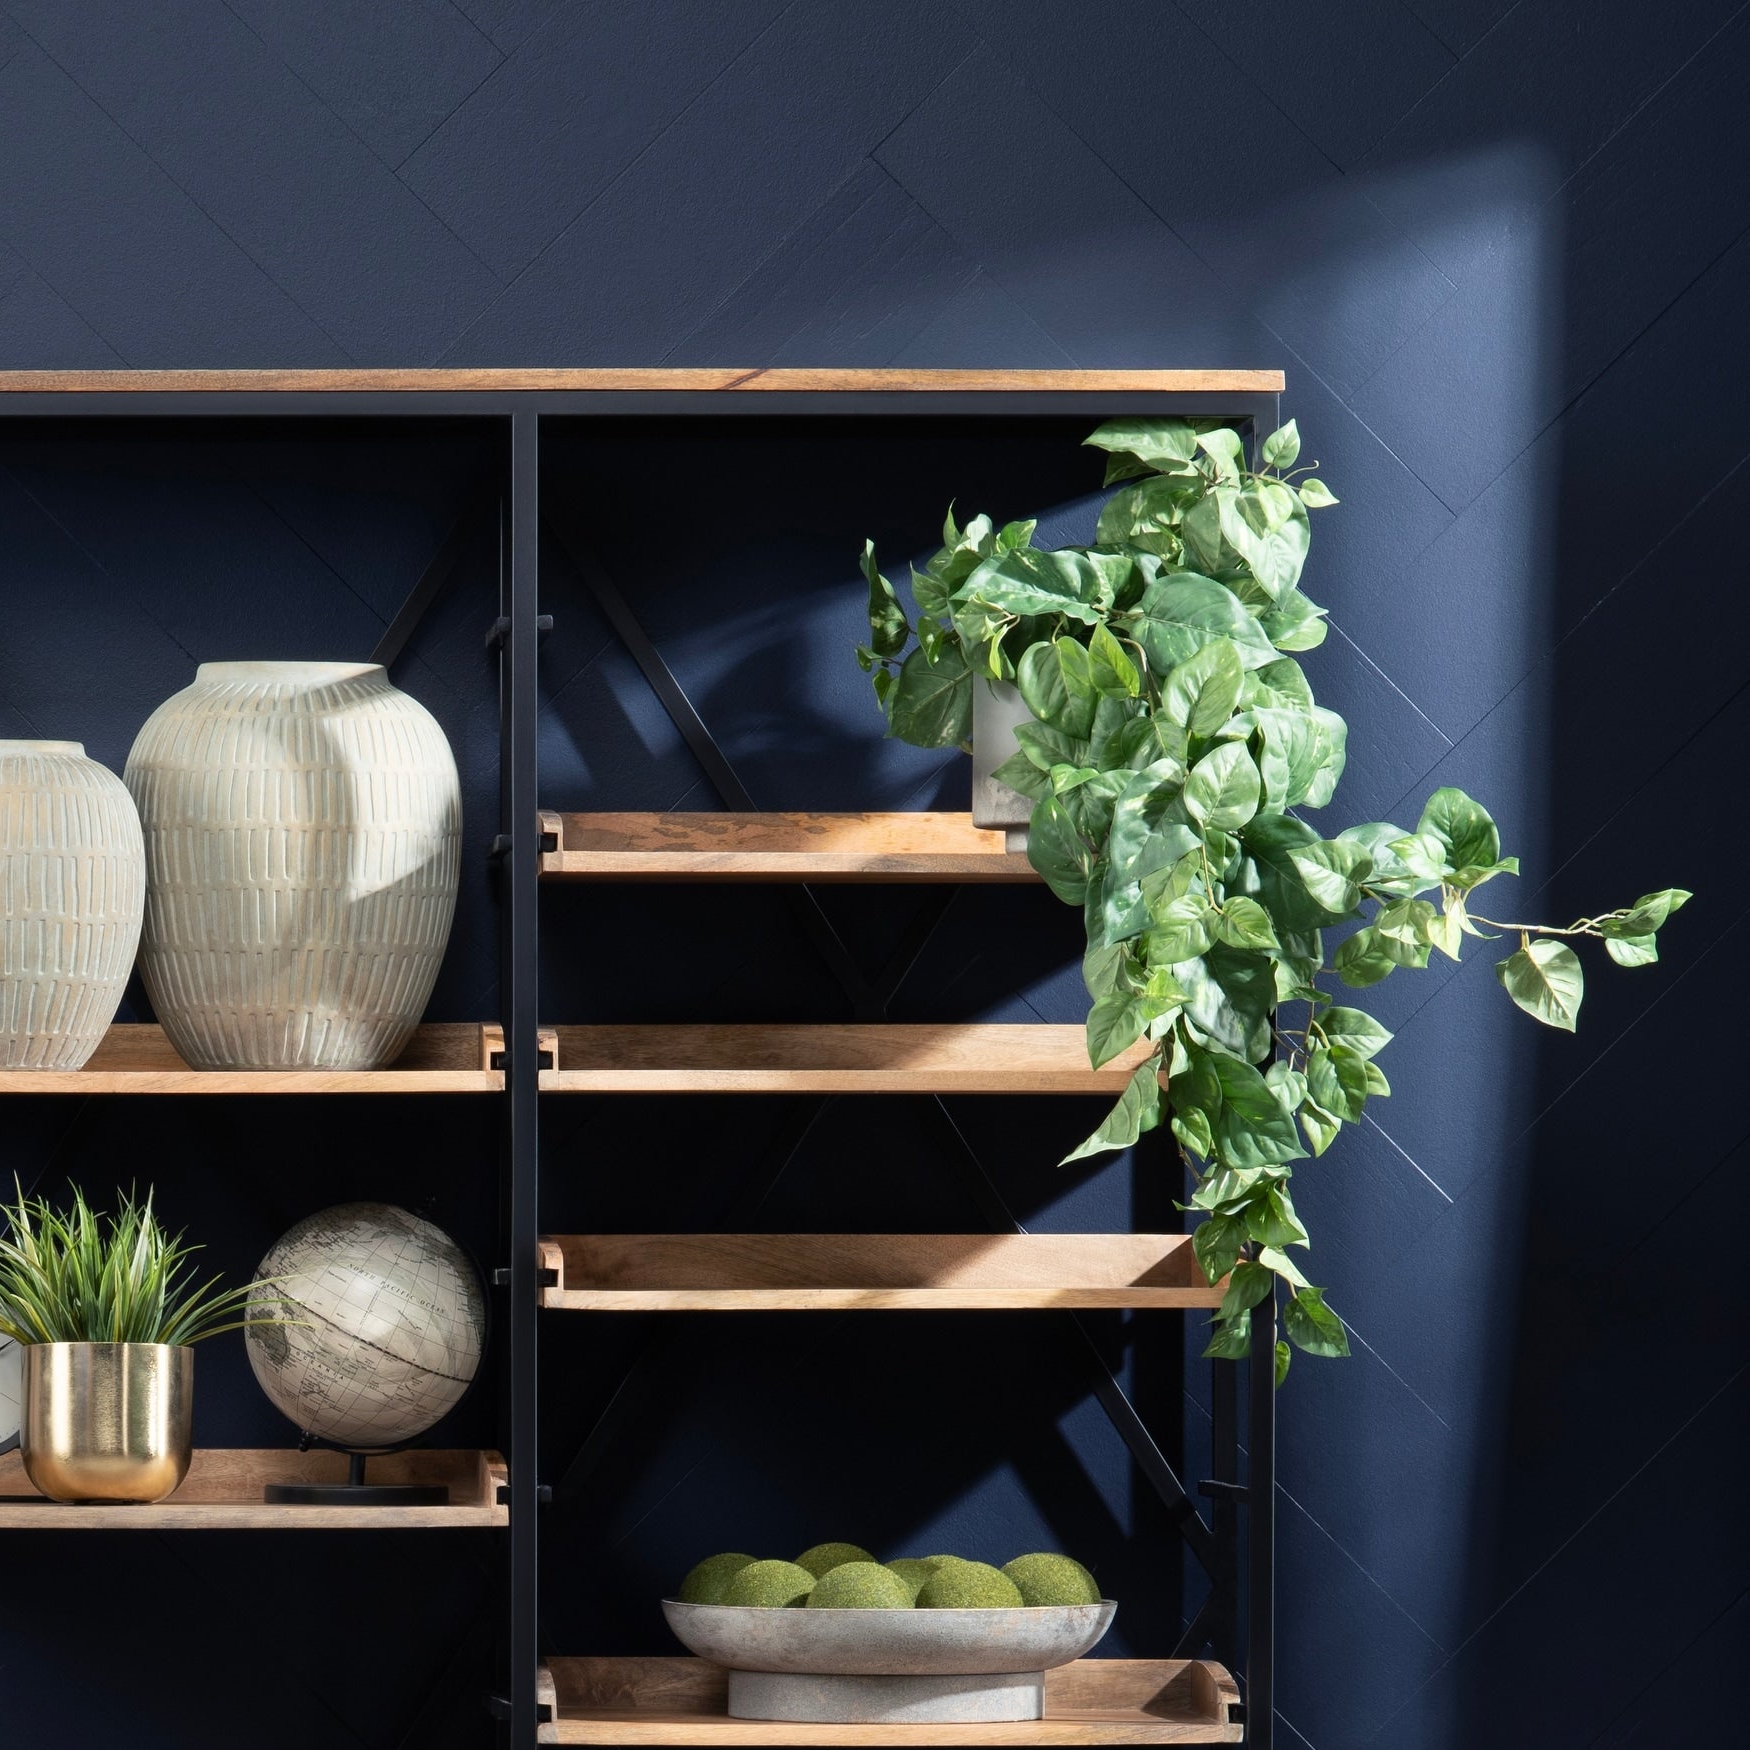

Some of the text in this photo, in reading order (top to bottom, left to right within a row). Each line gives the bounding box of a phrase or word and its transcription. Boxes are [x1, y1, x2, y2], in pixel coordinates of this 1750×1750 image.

[349, 1263, 376, 1281] NORTH
[380, 1280, 415, 1300] PACIFIC
[420, 1299, 445, 1314] OCEAN
[295, 1350, 344, 1380] OCEANIA
